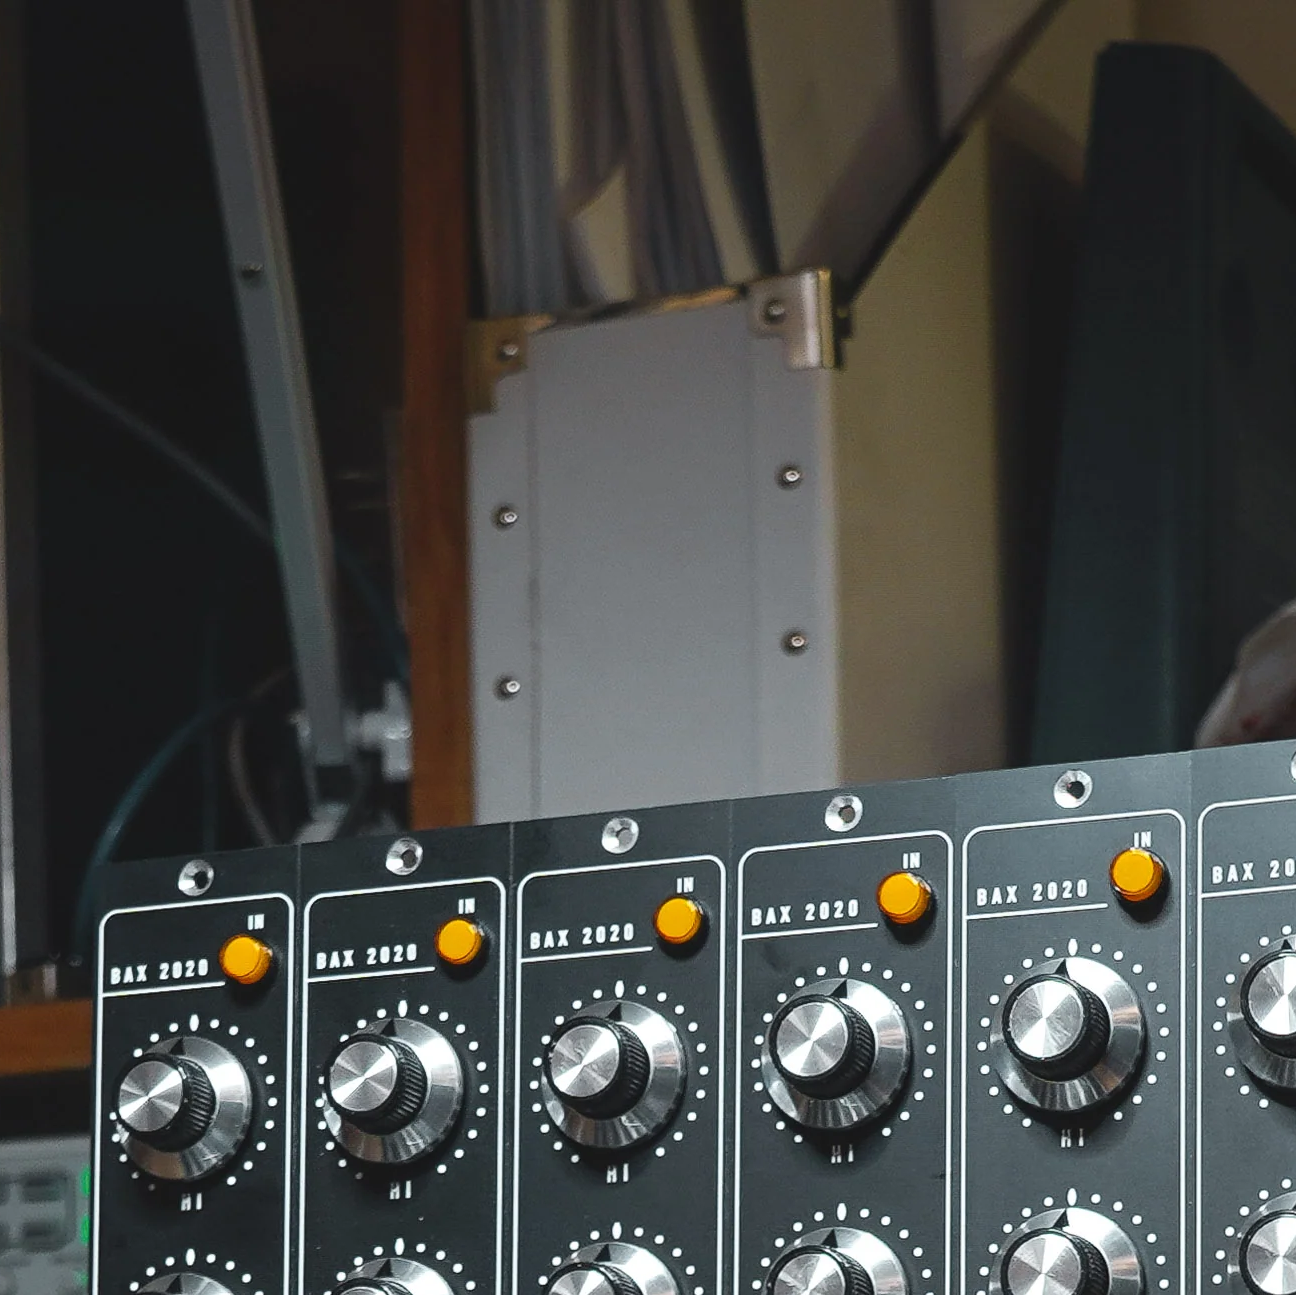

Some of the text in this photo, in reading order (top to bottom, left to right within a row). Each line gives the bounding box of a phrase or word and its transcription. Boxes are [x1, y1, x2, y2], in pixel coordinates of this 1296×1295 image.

[1133, 830, 1152, 849] IN
[902, 851, 921, 870] IN
[1212, 862, 1254, 884] BAX
[676, 876, 695, 894] IN
[976, 878, 1088, 907] BAX 2020
[458, 897, 476, 915] IN
[751, 898, 859, 926] BAX 2020
[247, 913, 265, 931] IN
[529, 922, 634, 950] BAX 2020
[316, 943, 417, 970] BAX 2020
[110, 958, 209, 985] BAX 2020
[1060, 1127, 1085, 1149] HI
[830, 1143, 854, 1164] HI
[606, 1163, 629, 1184] HI
[389, 1179, 412, 1200] HI
[180, 1191, 203, 1212] HI
